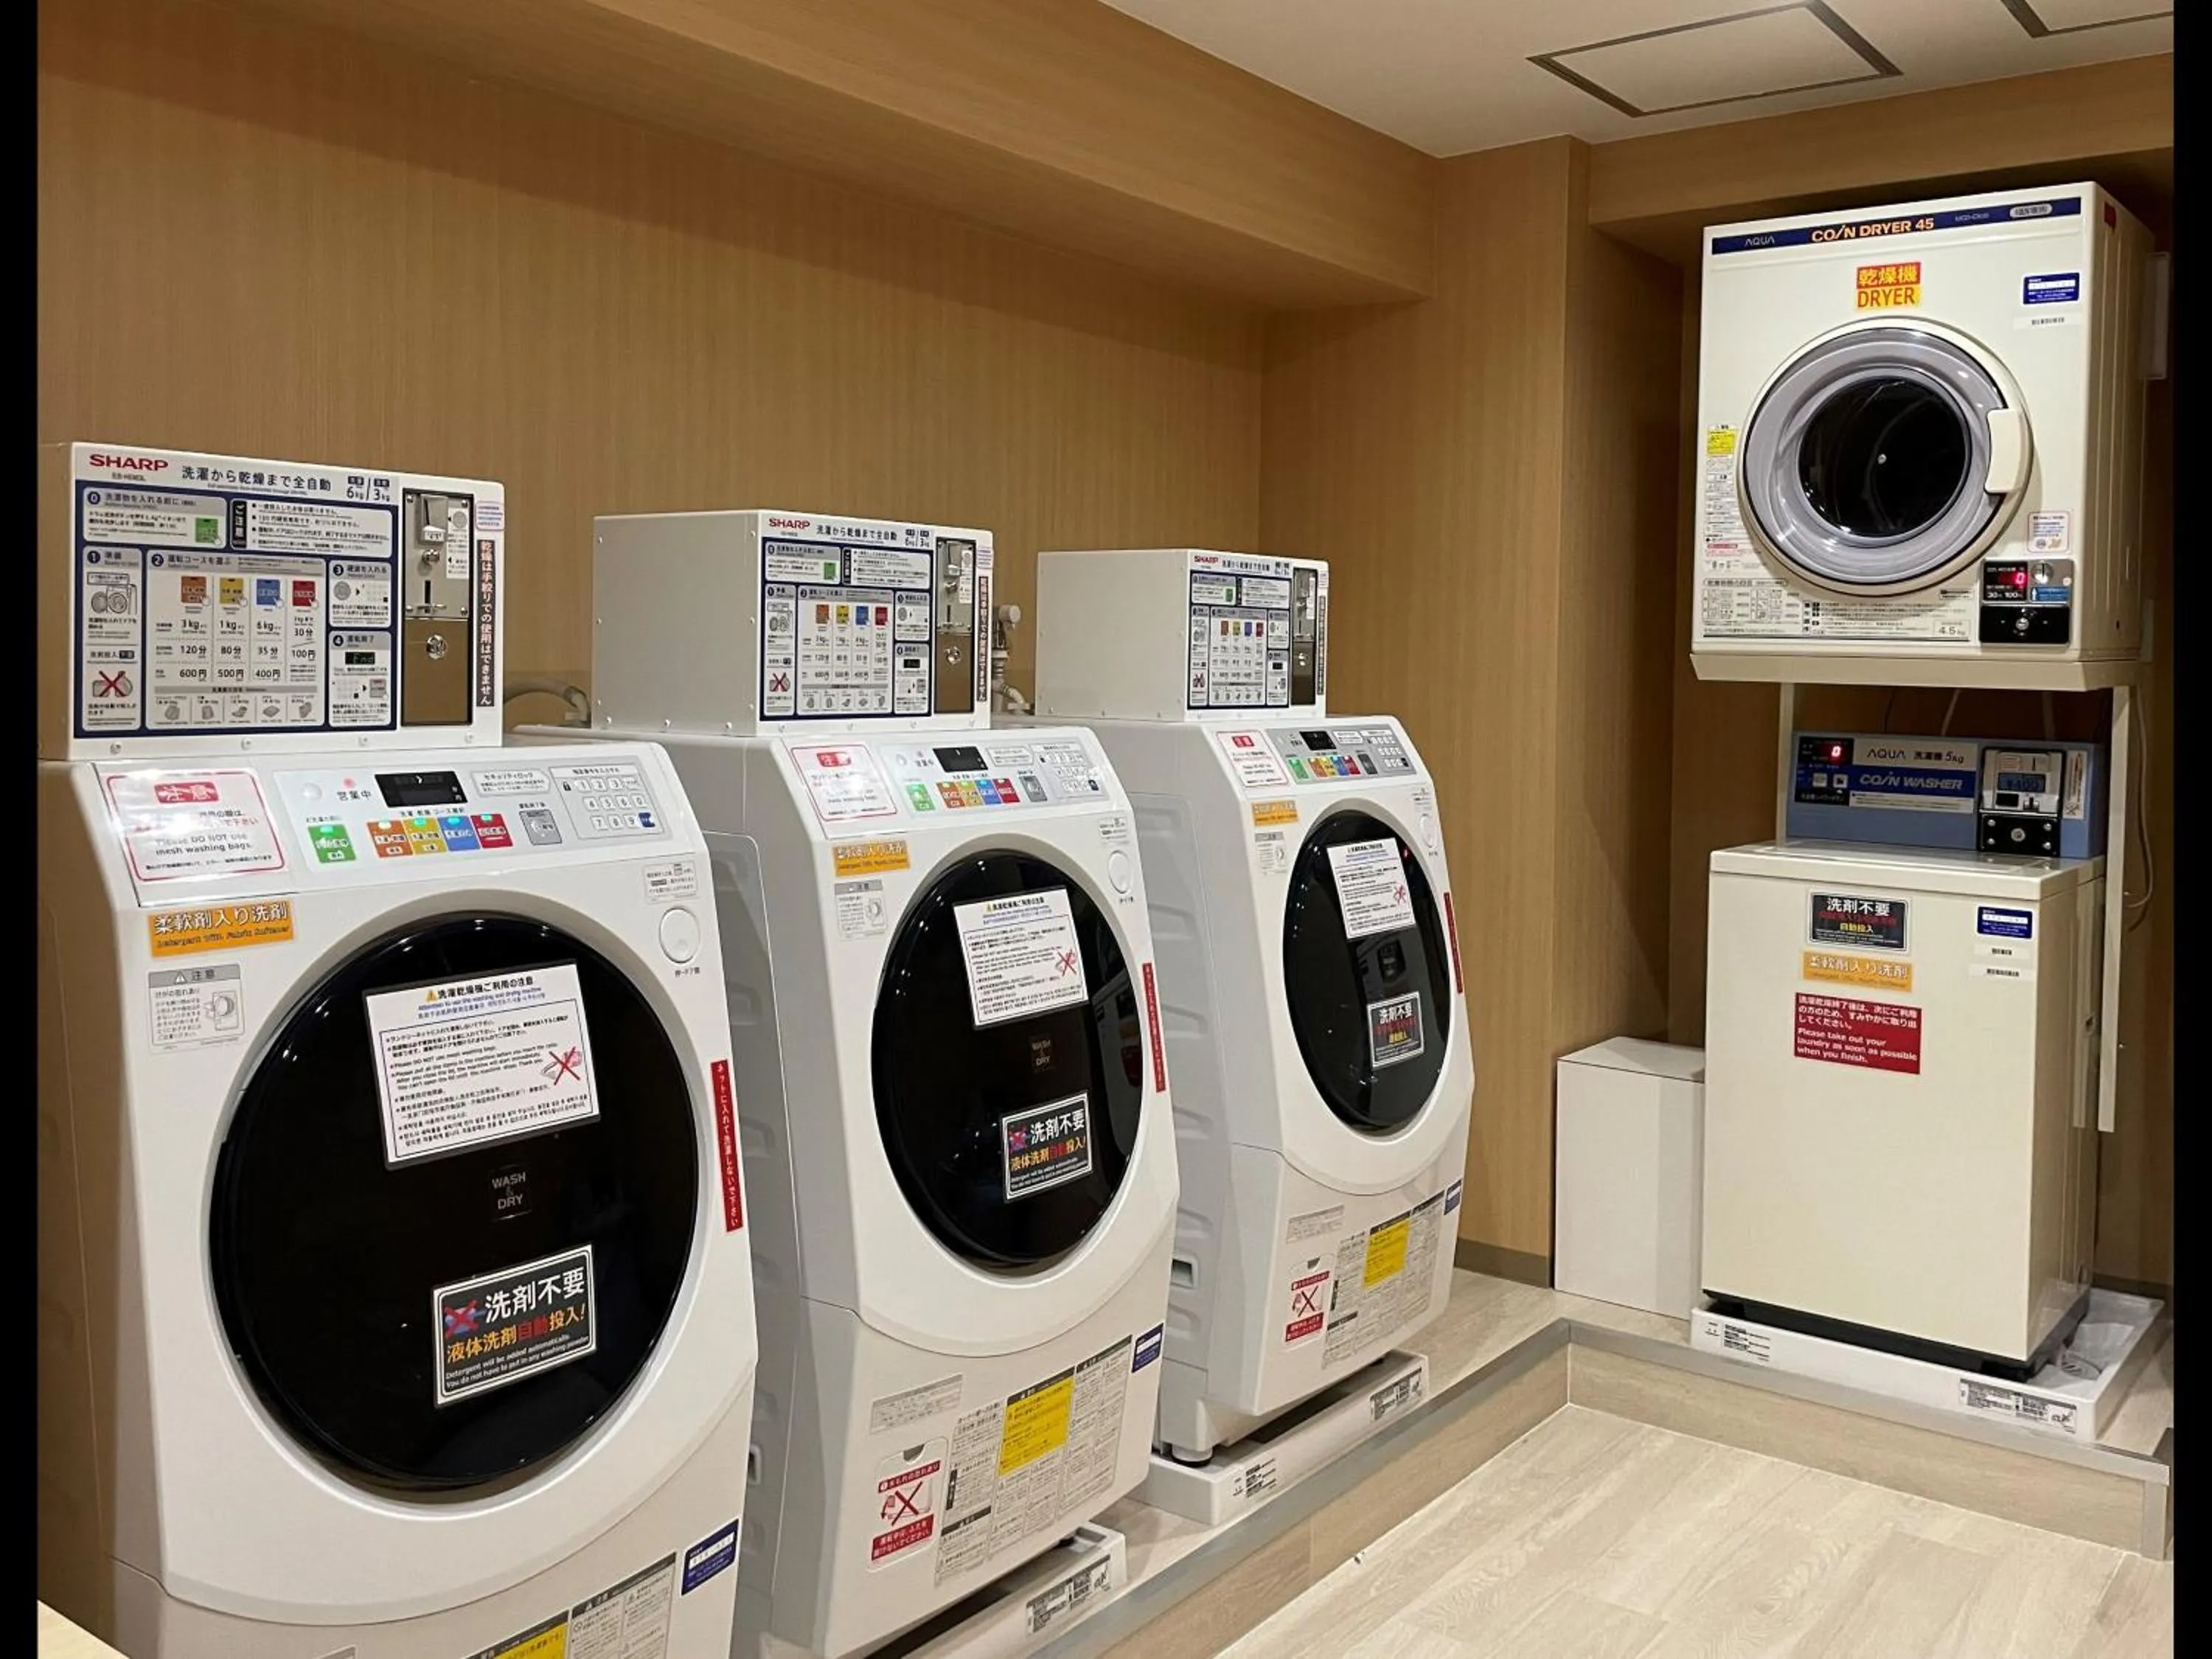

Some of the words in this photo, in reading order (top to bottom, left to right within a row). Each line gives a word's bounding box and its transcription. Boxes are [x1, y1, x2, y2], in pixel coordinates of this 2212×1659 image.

[1860, 222, 1912, 237] DRYER
[1916, 218, 1935, 230] 45
[1858, 266, 1919, 287] 乾燥機
[1857, 287, 1916, 308] DRYER
[89, 454, 169, 471] SHARP
[182, 465, 331, 492] 洗濯から乾燥まで全自動
[769, 518, 810, 529] SHARP
[1946, 751, 1964, 764] 5kg
[1903, 775, 1964, 791] WASHER
[186, 844, 226, 855] washing
[1826, 897, 1891, 917] 洗剤不要
[154, 901, 288, 936] 柔軟剤入り洗剤
[1798, 1028, 1826, 1037] Please
[1828, 1032, 1847, 1040] take
[1848, 1033, 1864, 1043] out
[1865, 1037, 1887, 1047] your
[1797, 1037, 1831, 1049] laundry
[1832, 1042, 1843, 1050] as
[1844, 1044, 1866, 1054] soon
[1867, 1047, 1878, 1055] as
[1880, 1049, 1918, 1061] possible
[1797, 1046, 1820, 1056] when
[1822, 1050, 1839, 1060] you
[1840, 1052, 1868, 1064] finish.
[1030, 1107, 1085, 1146] 洗剤不要
[491, 1172, 526, 1190] WASH
[497, 1194, 524, 1210] DRY
[484, 1265, 586, 1324] 洗剤不要
[445, 1363, 481, 1380] Detergent
